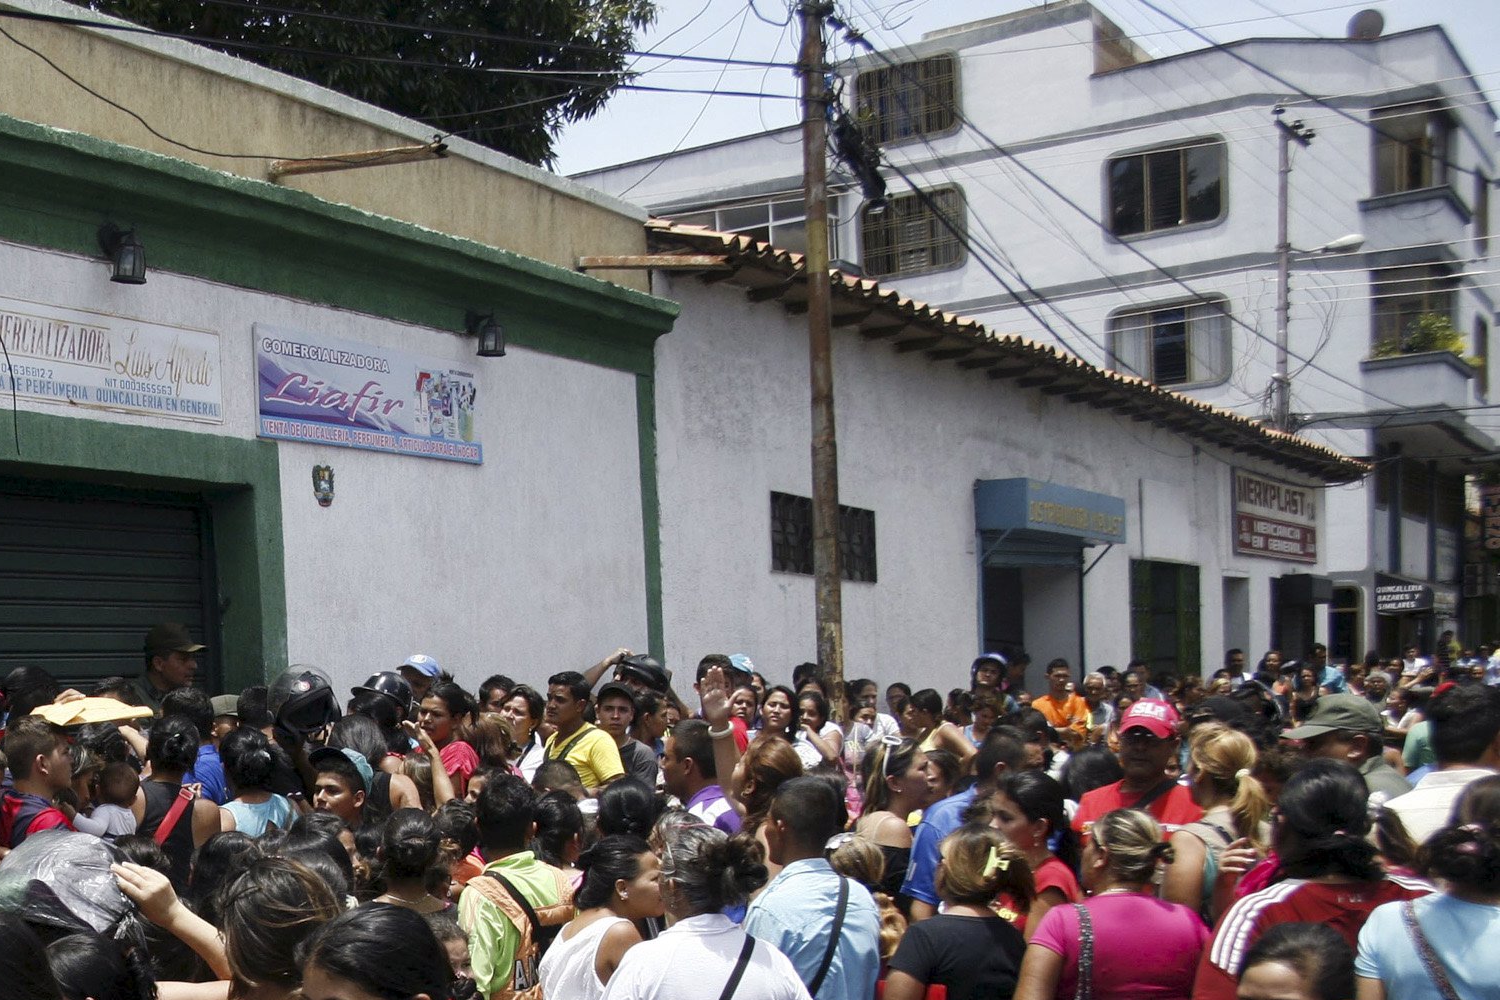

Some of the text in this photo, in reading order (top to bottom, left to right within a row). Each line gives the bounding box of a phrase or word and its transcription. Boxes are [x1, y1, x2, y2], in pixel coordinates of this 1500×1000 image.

[115, 328, 155, 381] Luis
[262, 338, 390, 373] COMERCIALIZADORA
[10, 376, 22, 391] DE
[26, 379, 88, 400] PERFUMERIA
[96, 389, 163, 409] QUINCALLERIA
[166, 399, 177, 411] EN
[180, 400, 219, 416] GENERAL
[105, 378, 117, 388] NIT
[264, 420, 289, 435] VENTA
[290, 423, 300, 436] DE
